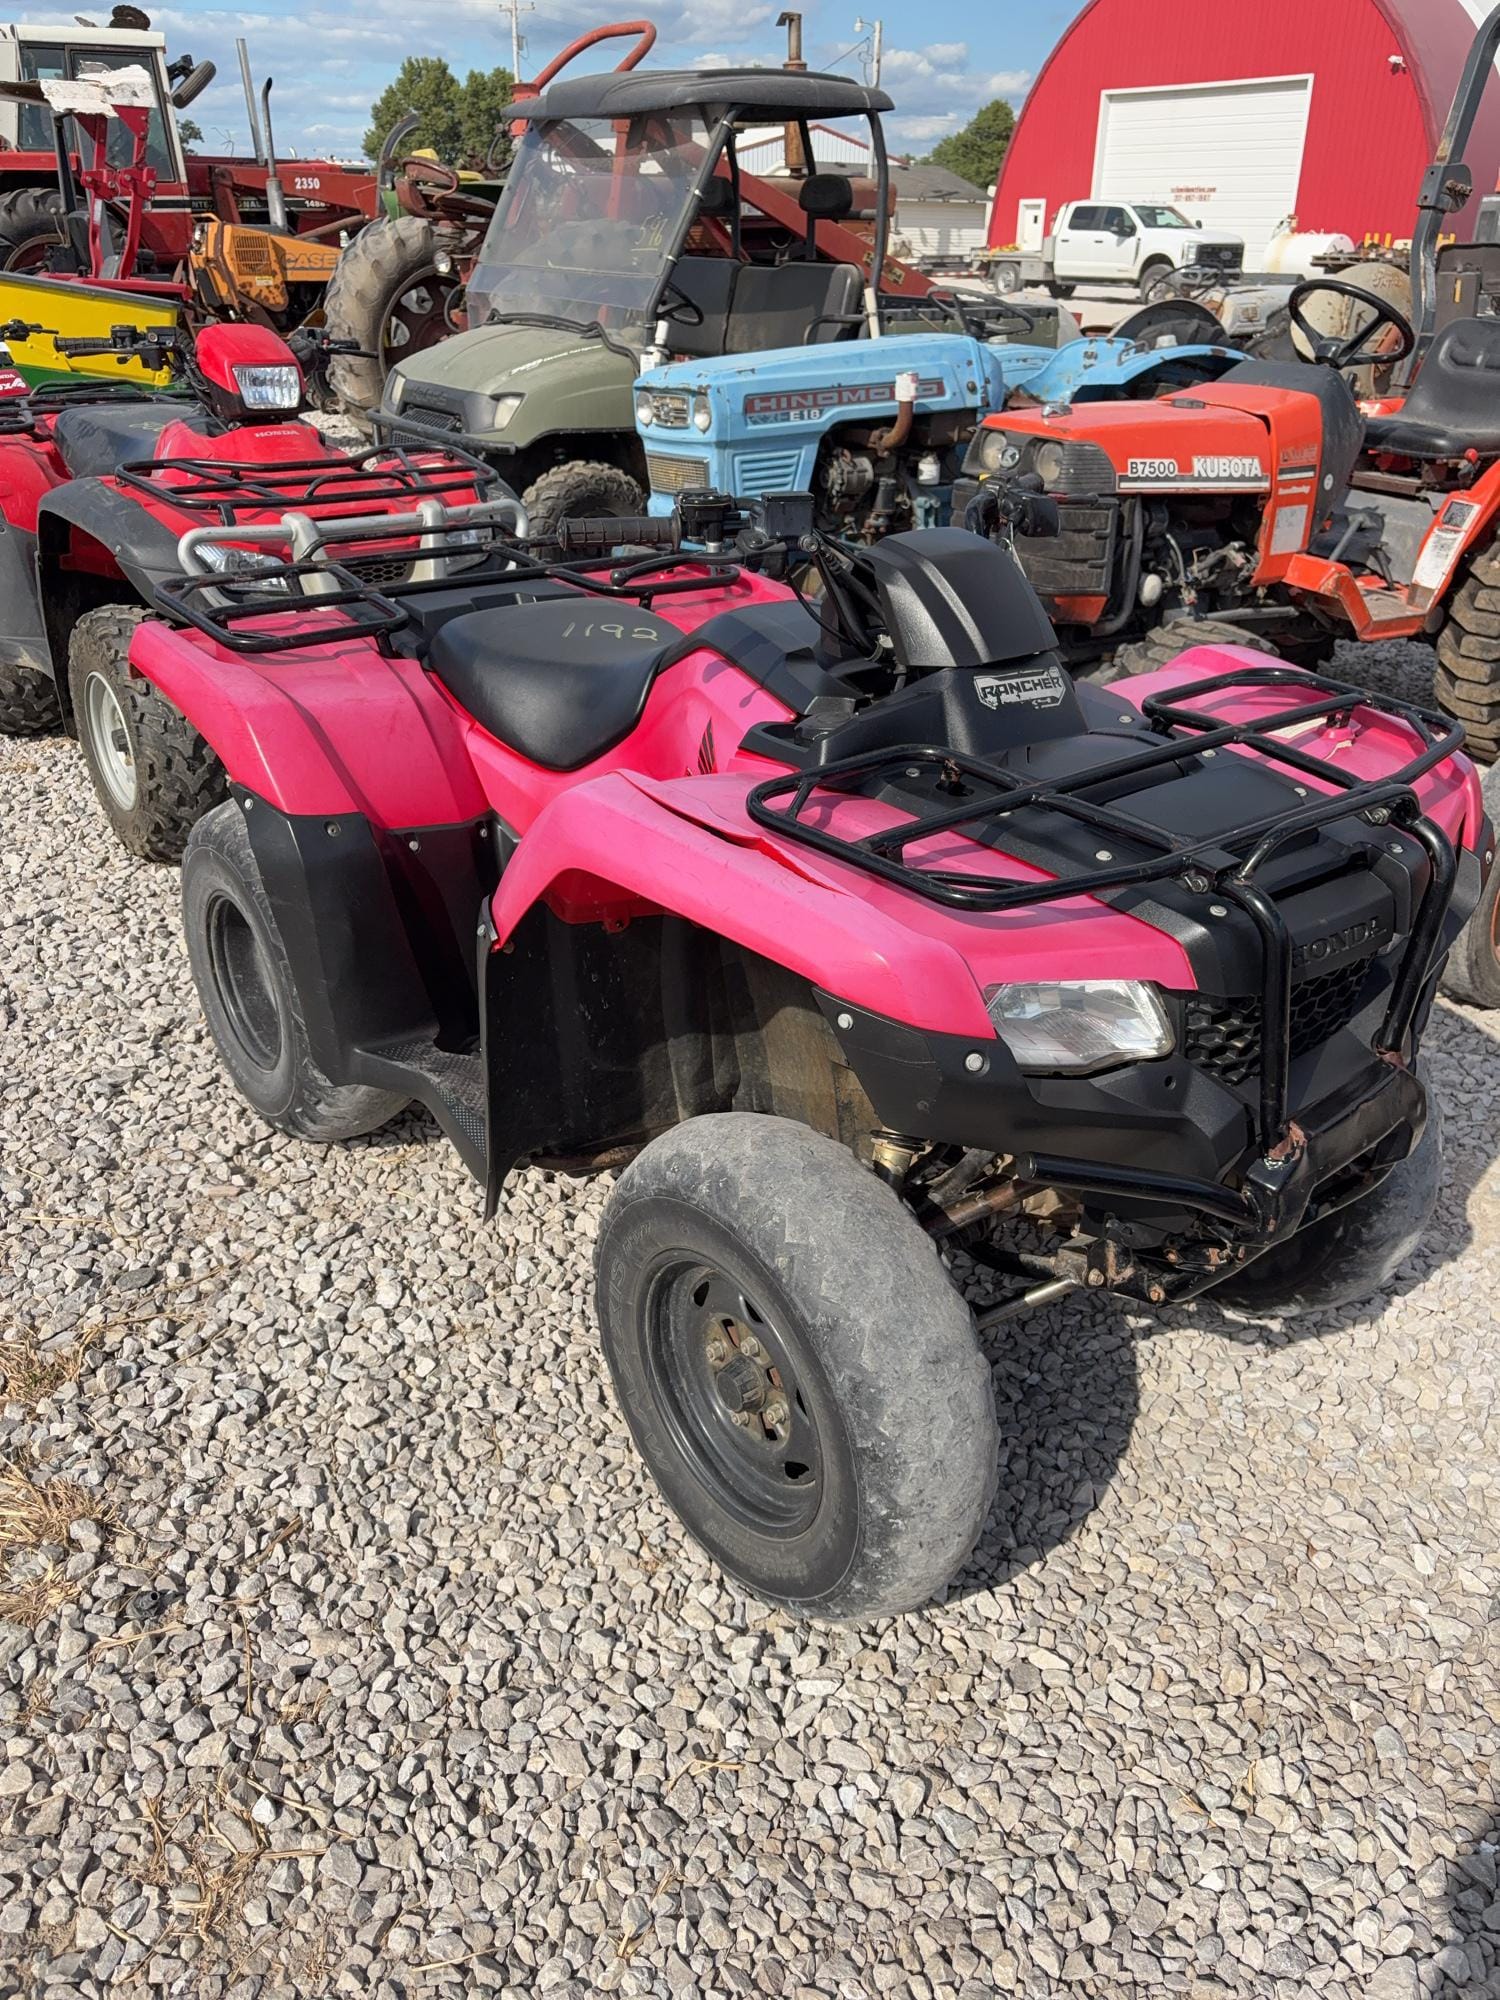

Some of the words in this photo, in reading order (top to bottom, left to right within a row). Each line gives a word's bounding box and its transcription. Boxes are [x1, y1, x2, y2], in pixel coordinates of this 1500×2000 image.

[295, 177, 320, 190] 2350
[285, 252, 338, 269] CASE
[755, 384, 938, 412] HINOMOO
[789, 409, 821, 422] E18
[254, 429, 300, 438] HONDA
[1129, 460, 1176, 476] B7500
[1193, 456, 1262, 478] KUBOTA
[561, 622, 658, 641] 1192
[980, 676, 1062, 699] RANCHER
[1293, 916, 1387, 968] HONDA
